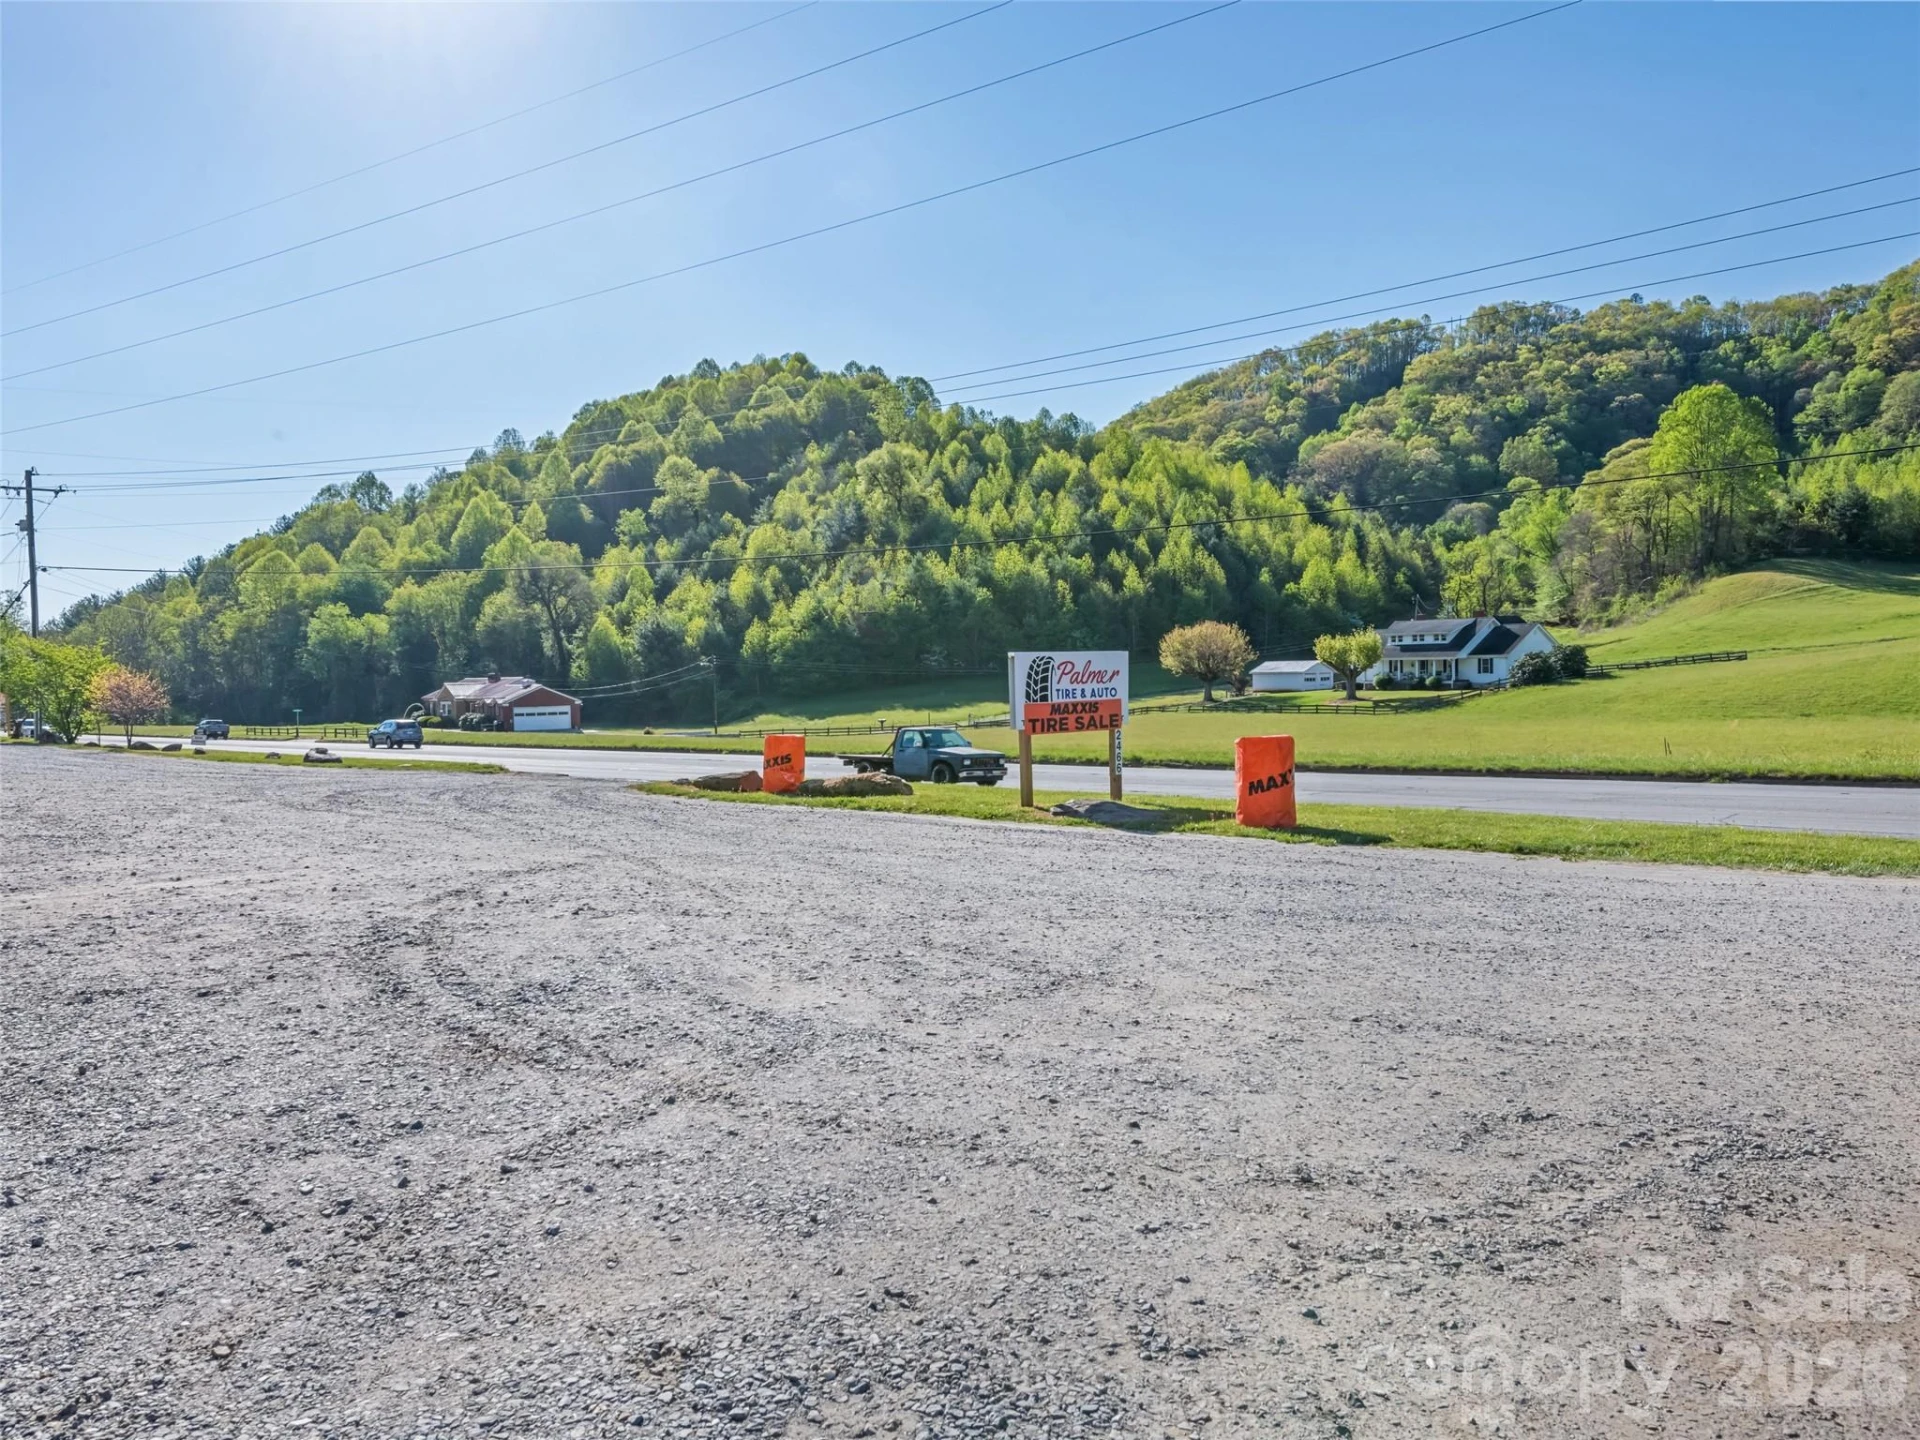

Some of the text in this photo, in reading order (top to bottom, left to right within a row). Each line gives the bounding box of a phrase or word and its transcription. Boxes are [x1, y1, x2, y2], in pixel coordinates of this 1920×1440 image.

[1057, 660, 1120, 685] Palmer
[1056, 687, 1117, 699] TIRE & AUTO
[1050, 702, 1099, 716] MAXXIS
[1028, 713, 1119, 733] TIRE SALE
